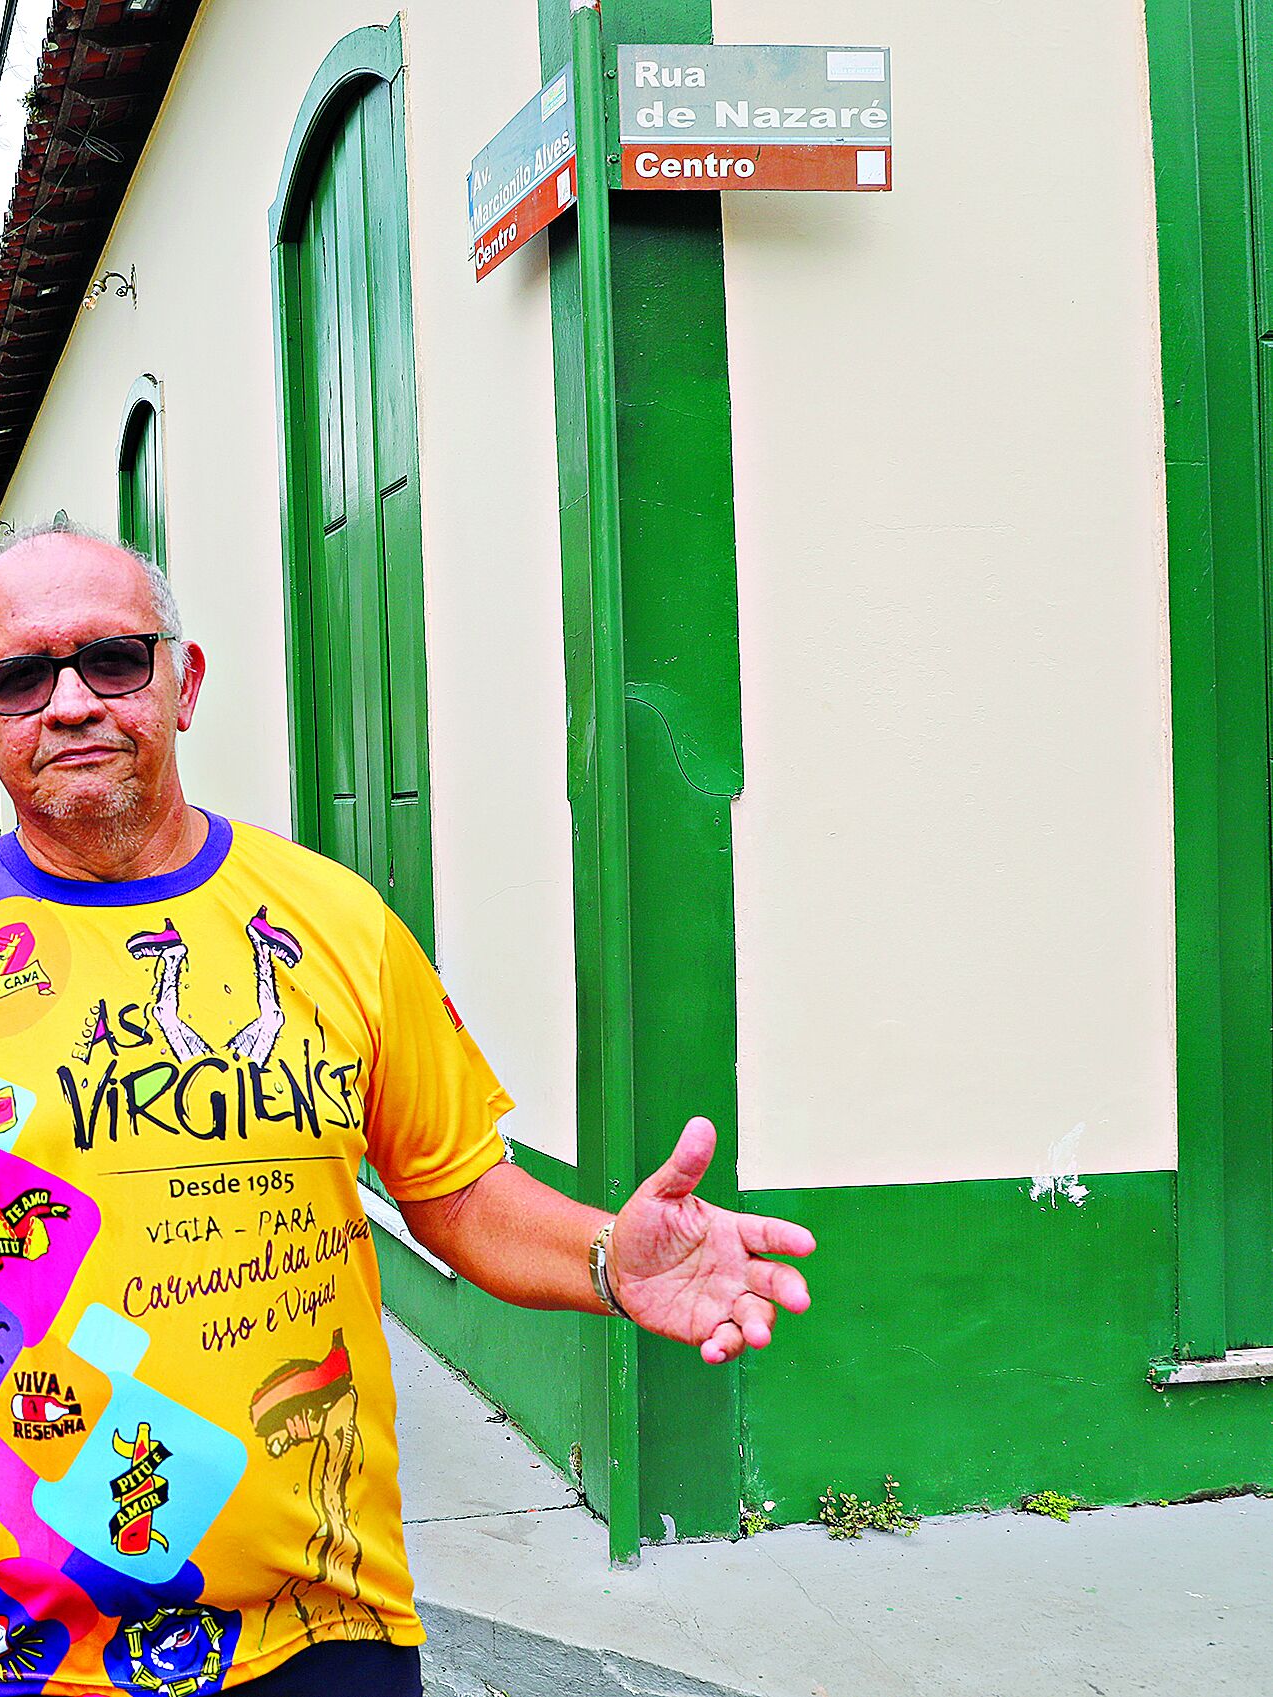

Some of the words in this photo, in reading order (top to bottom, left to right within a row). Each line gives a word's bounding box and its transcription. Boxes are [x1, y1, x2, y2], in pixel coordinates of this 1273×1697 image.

[634, 61, 706, 89] Rua
[635, 101, 697, 129] de
[715, 99, 888, 129] Nazaré
[473, 165, 531, 230] Marcionilo
[534, 130, 570, 177] Alves
[473, 166, 492, 197] Av.
[634, 152, 756, 179] Centro
[475, 223, 517, 270] Centro
[4, 971, 39, 989] CANA
[86, 998, 154, 1066] AS
[169, 1173, 240, 1198] Desde
[247, 1169, 295, 1196] 1985
[5, 1203, 25, 1224] TE
[21, 1191, 49, 1211] AMO
[146, 1215, 223, 1245] VIGIA
[258, 1202, 317, 1236] PARÁ
[123, 1239, 278, 1318] Carnaval
[282, 1243, 310, 1274] da
[202, 1315, 258, 1352] isso
[276, 1275, 336, 1327] Vigia!
[14, 1371, 61, 1396] VIVA
[64, 1385, 77, 1402] A
[13, 1417, 87, 1441] RESENHA
[116, 1493, 162, 1527] AMOR
